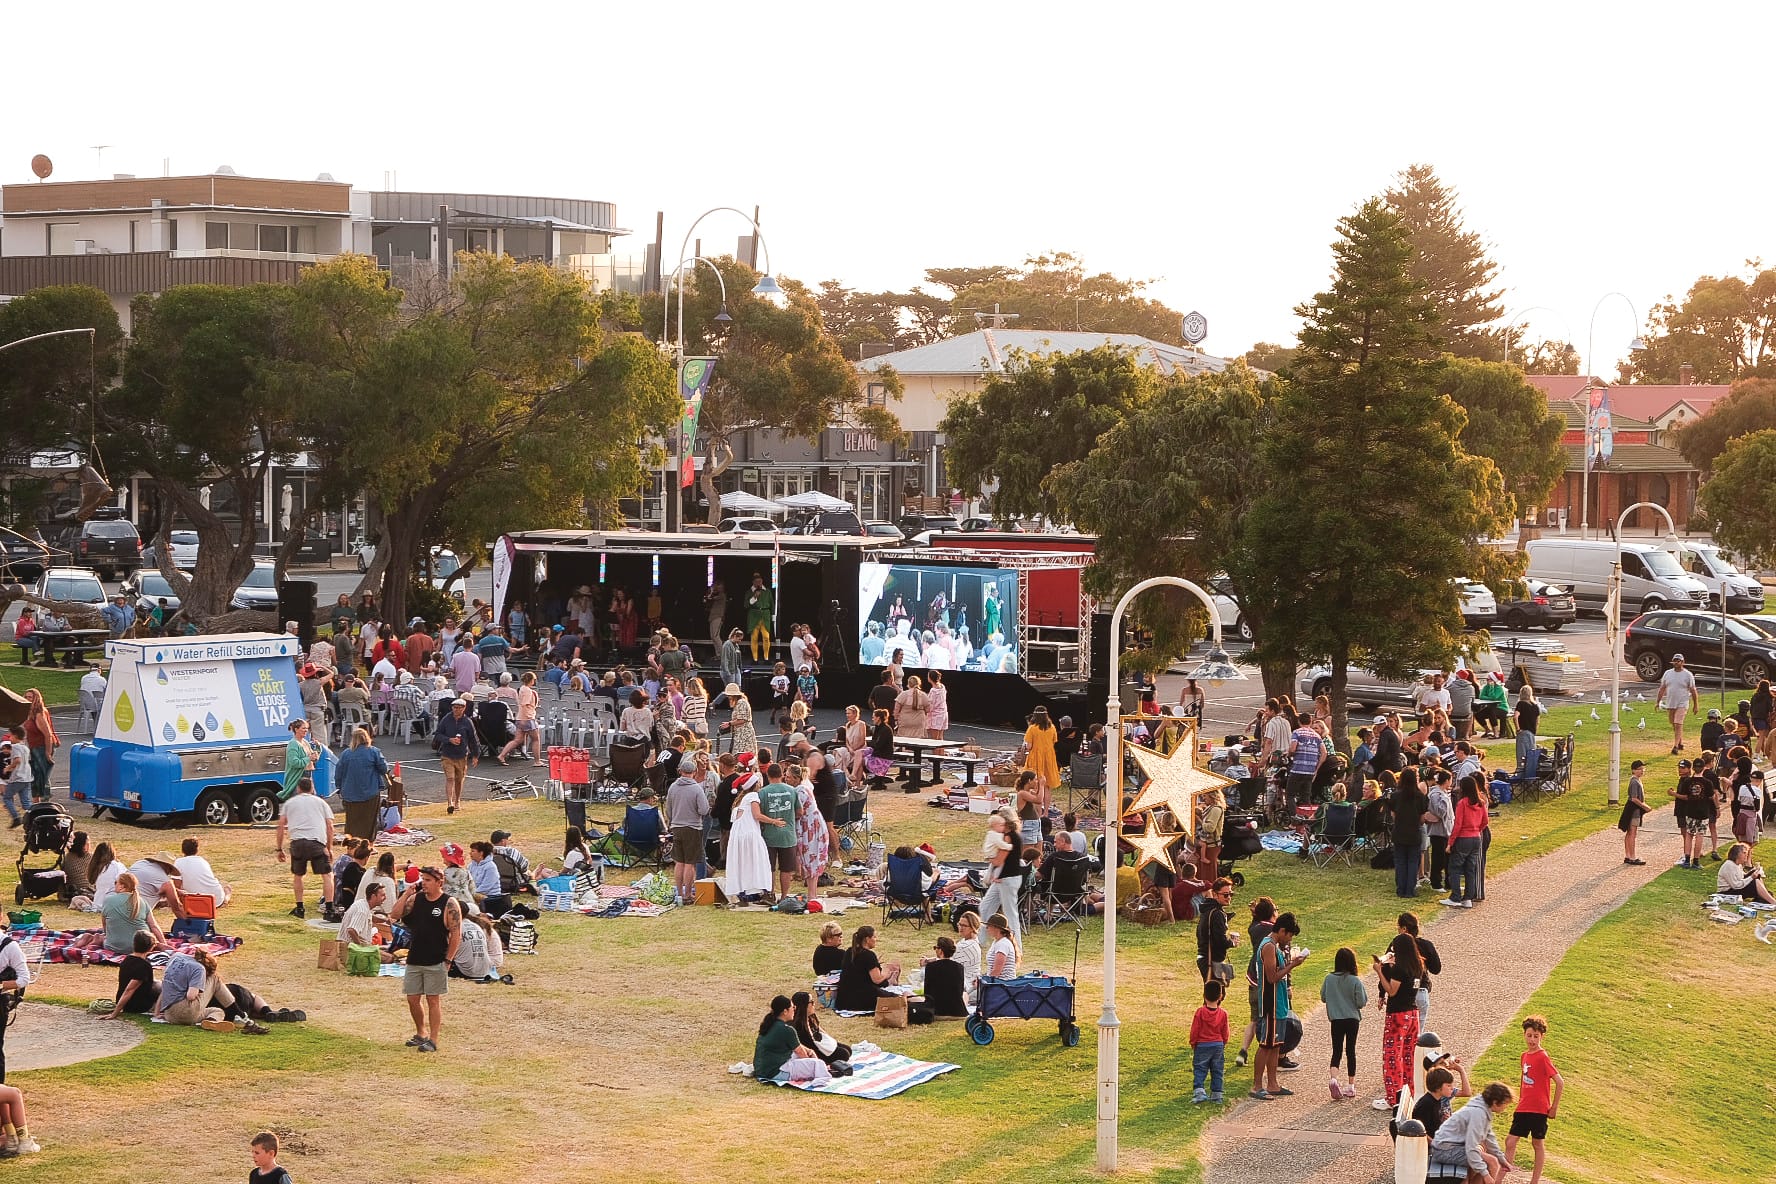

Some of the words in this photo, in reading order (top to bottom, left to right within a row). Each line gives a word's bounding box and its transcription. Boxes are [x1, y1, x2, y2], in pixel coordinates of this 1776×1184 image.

[173, 648, 203, 659] Water
[206, 646, 233, 658] Refill
[236, 645, 271, 656] Station
[170, 668, 218, 676] WESTERNPORT
[258, 669, 274, 681] BE
[251, 681, 285, 695] SMART
[255, 695, 288, 706] CHOOSE
[258, 706, 290, 727] TAP
